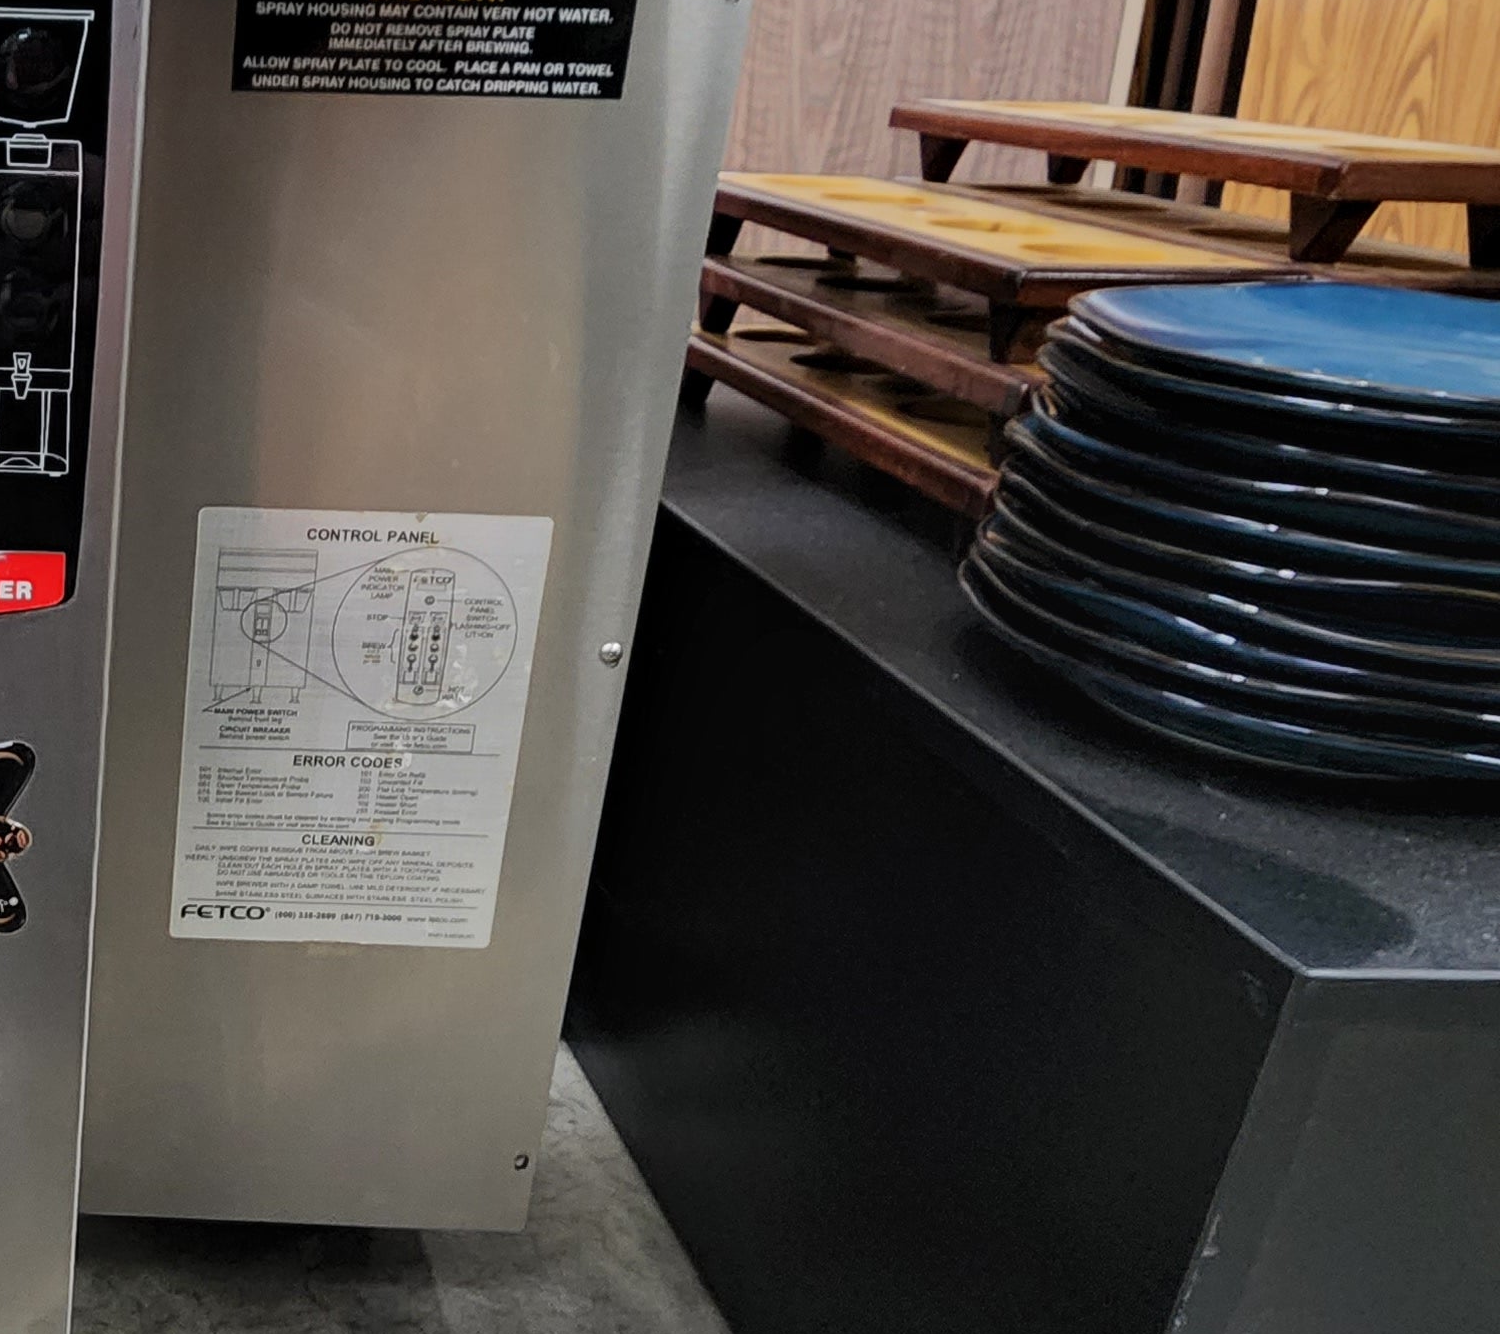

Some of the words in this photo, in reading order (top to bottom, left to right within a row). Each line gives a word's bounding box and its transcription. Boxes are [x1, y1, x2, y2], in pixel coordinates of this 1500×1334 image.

[256, 1, 303, 17] SPRAY
[307, 2, 375, 18] HOUSING
[378, 4, 410, 19] MAY
[413, 5, 478, 20] CONTAIN
[482, 6, 520, 21] VERY
[522, 7, 556, 22] HOT
[330, 23, 351, 36] DO
[353, 23, 382, 37] NOT
[385, 24, 442, 38] REMOVE
[446, 25, 490, 39] SPRAY
[491, 25, 535, 40] PLATE
[328, 38, 415, 52] IMMEDIATELY
[419, 40, 462, 53] AFTER
[243, 56, 290, 70] ALLOW
[292, 57, 336, 71] SPRAY
[338, 58, 380, 72] PLATE
[384, 59, 402, 72] TO
[454, 60, 498, 74] PLACE
[499, 61, 510, 75] A
[511, 61, 541, 75] PAN
[542, 62, 564, 76] OR
[567, 62, 613, 77] TOWEL
[251, 75, 298, 88] UNDER
[302, 76, 345, 89] SPRAY
[348, 77, 410, 91] HOUSING
[415, 78, 433, 91] TO
[435, 79, 480, 92] CATCH
[483, 79, 548, 94] DRIPPING
[307, 528, 382, 542] CONTROL
[387, 530, 440, 545] PANEL
[292, 755, 346, 767] ERROR
[350, 756, 403, 769] CODES
[301, 834, 375, 847] CLEANING
